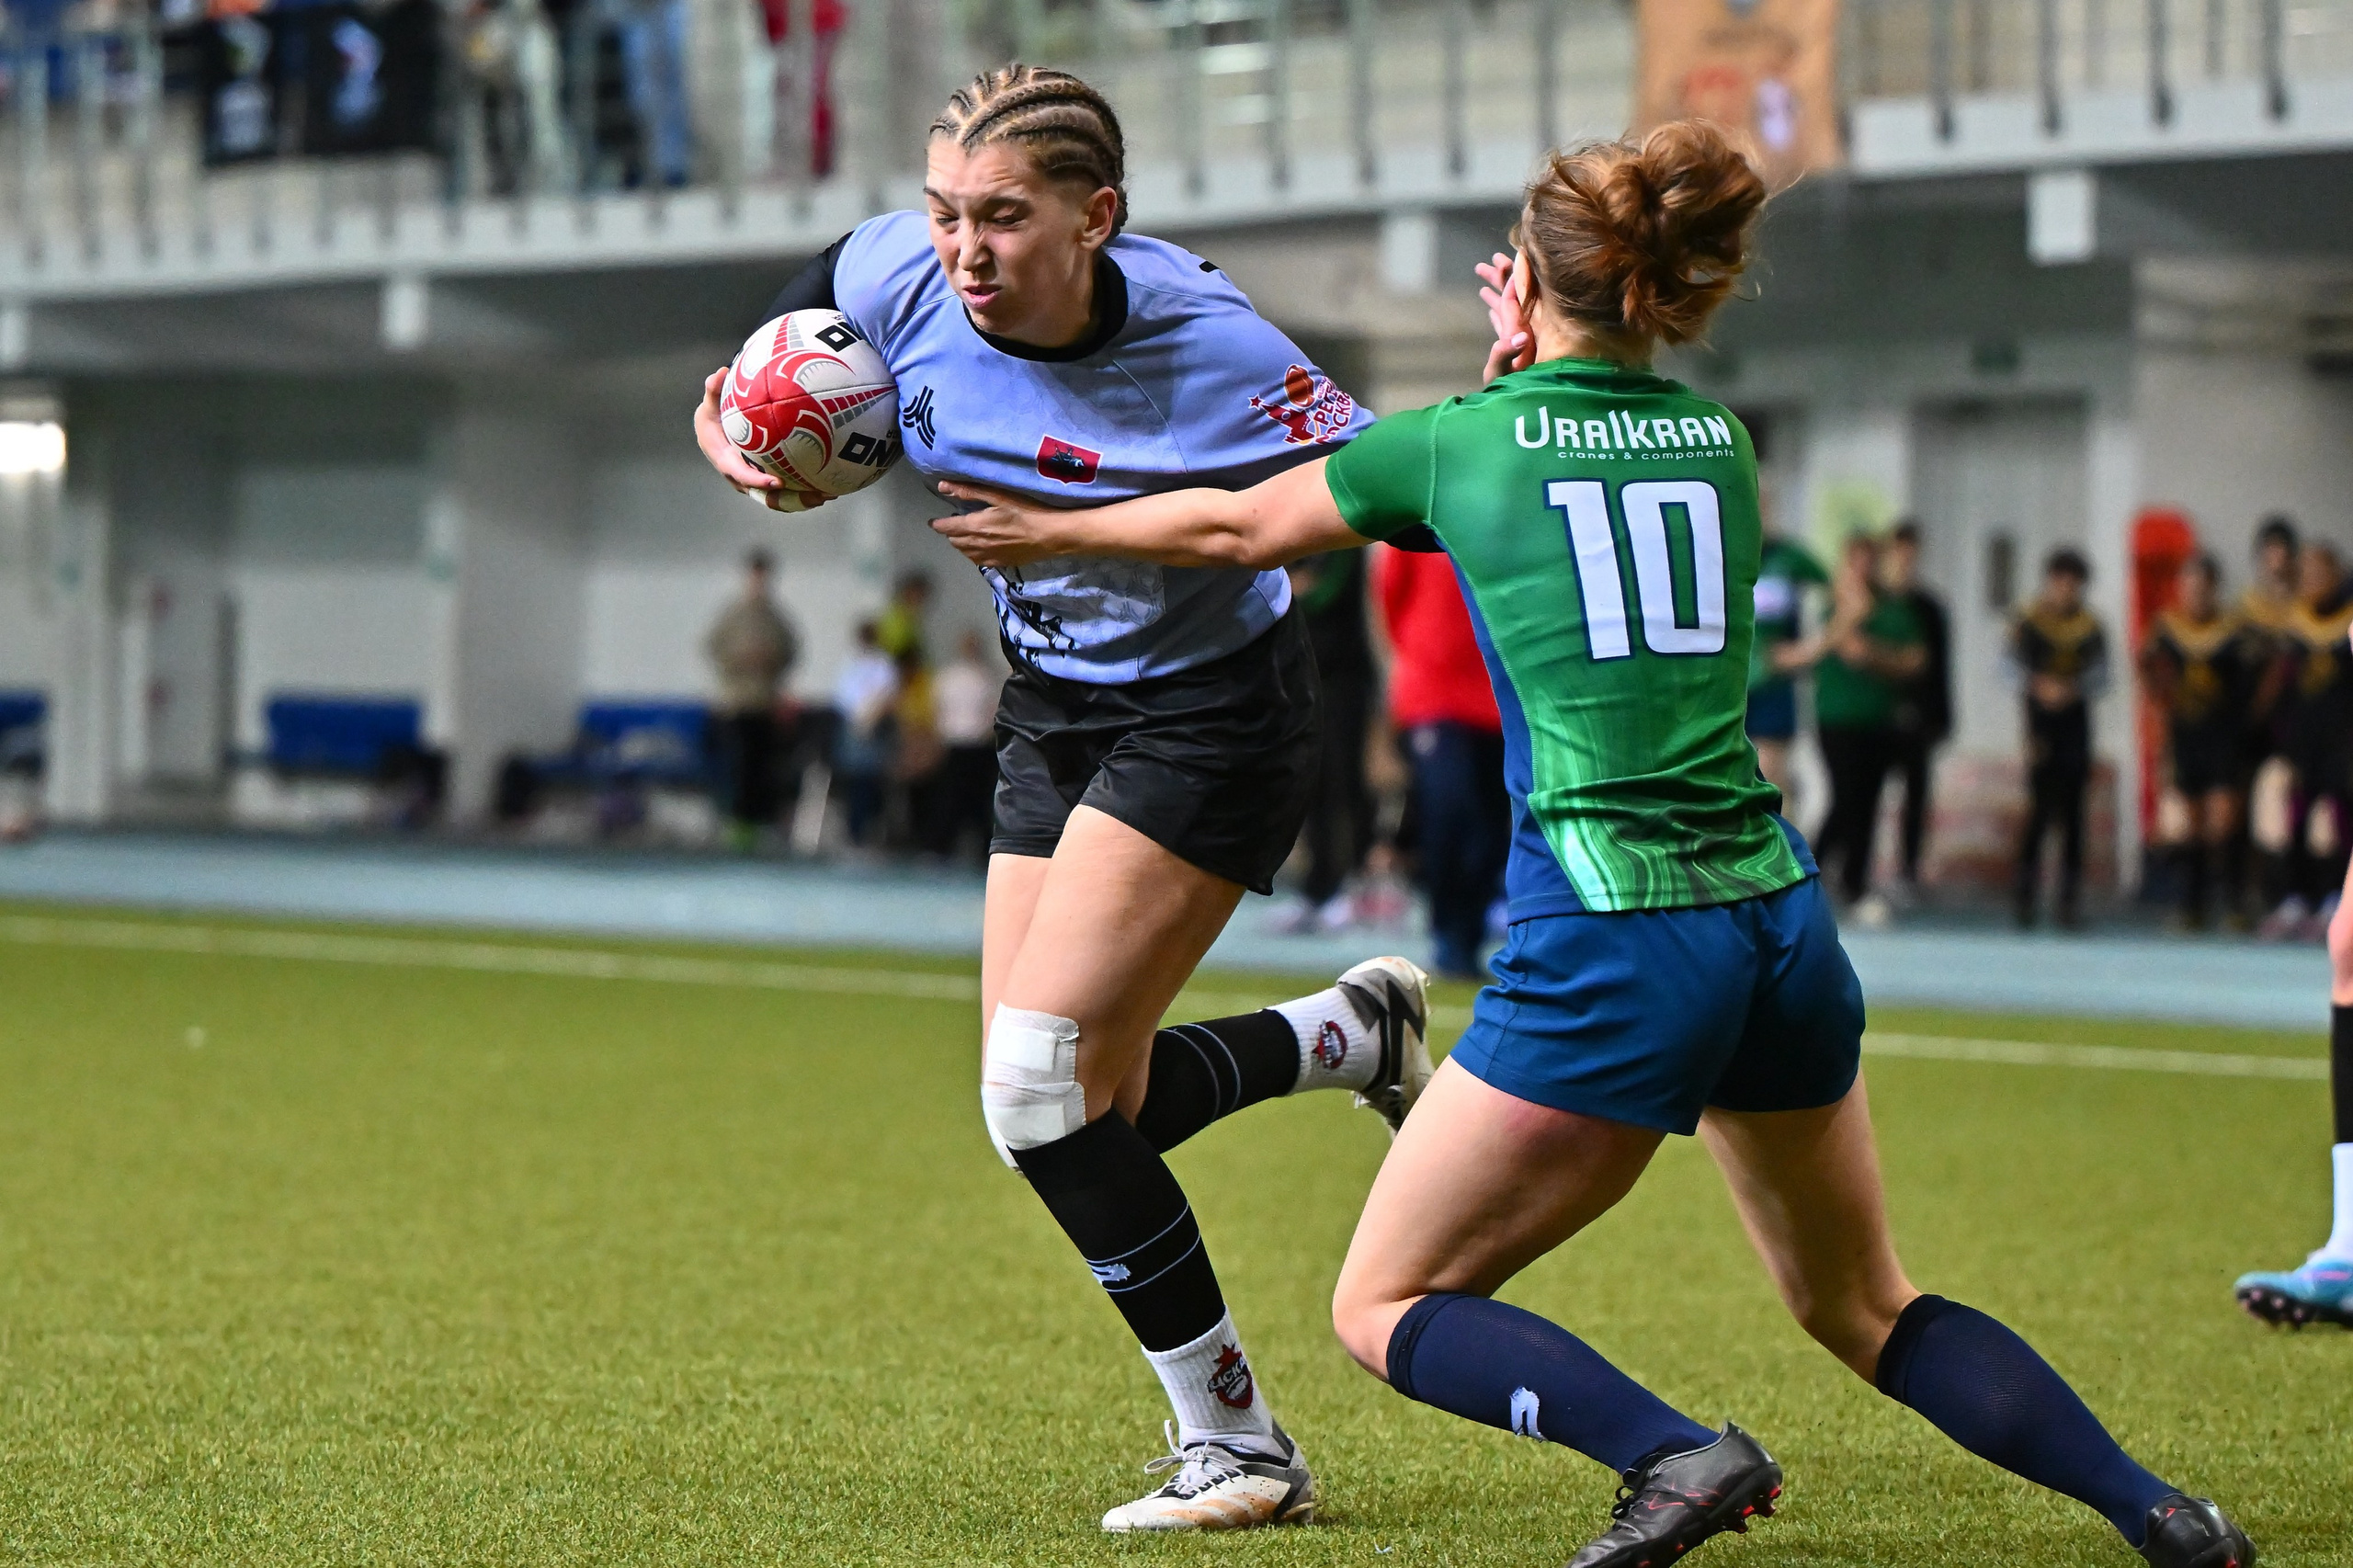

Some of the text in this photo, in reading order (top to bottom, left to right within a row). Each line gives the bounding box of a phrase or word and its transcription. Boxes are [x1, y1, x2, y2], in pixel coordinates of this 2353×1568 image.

[1557, 448, 1735, 461] cranes & components
[1543, 478, 1726, 661] 10
